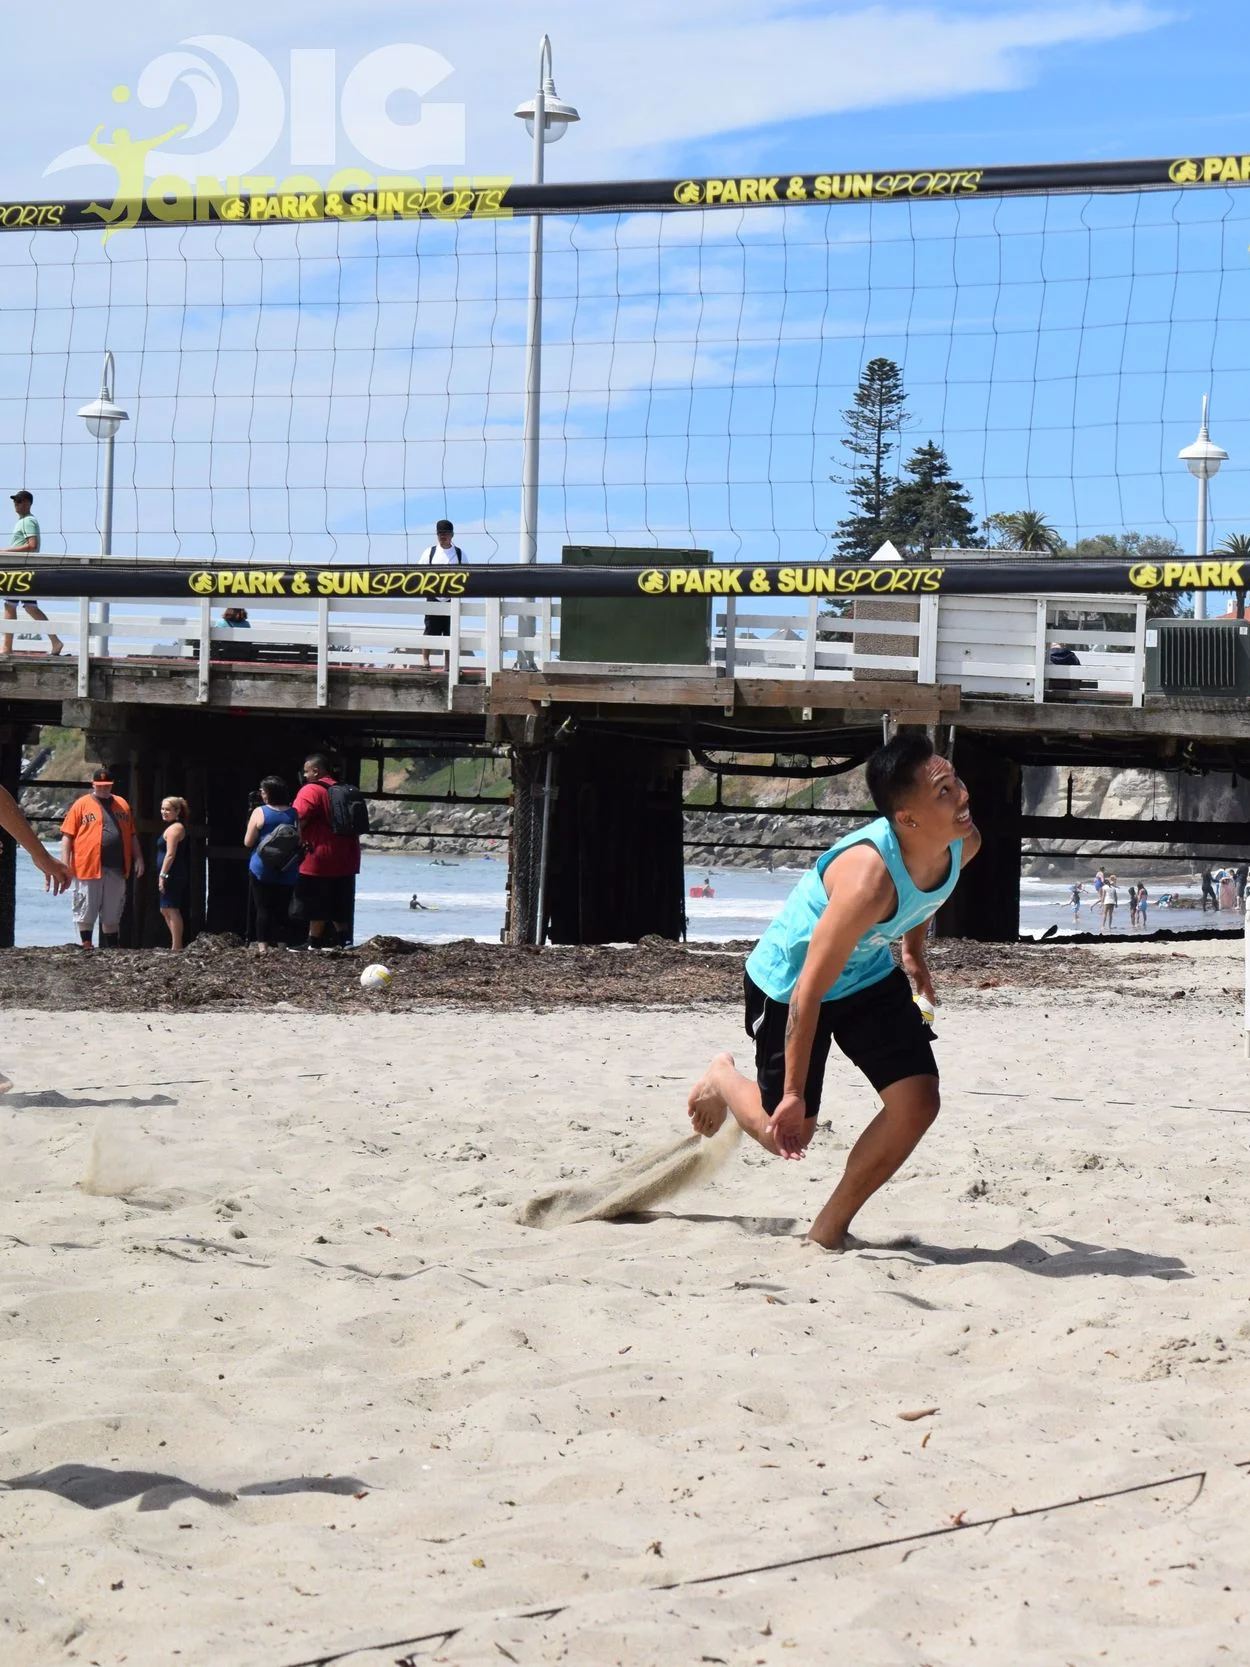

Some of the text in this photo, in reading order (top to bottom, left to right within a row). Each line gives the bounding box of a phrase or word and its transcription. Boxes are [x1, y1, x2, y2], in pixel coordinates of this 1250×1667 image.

[706, 170, 983, 204] PARK & SUN SPORTS
[249, 193, 318, 220] PARK
[323, 191, 348, 217] &
[218, 571, 469, 595] PARK & SUN SPORTS
[670, 567, 945, 593] PARK & SUN SPORTS
[1164, 561, 1245, 588] PARK
